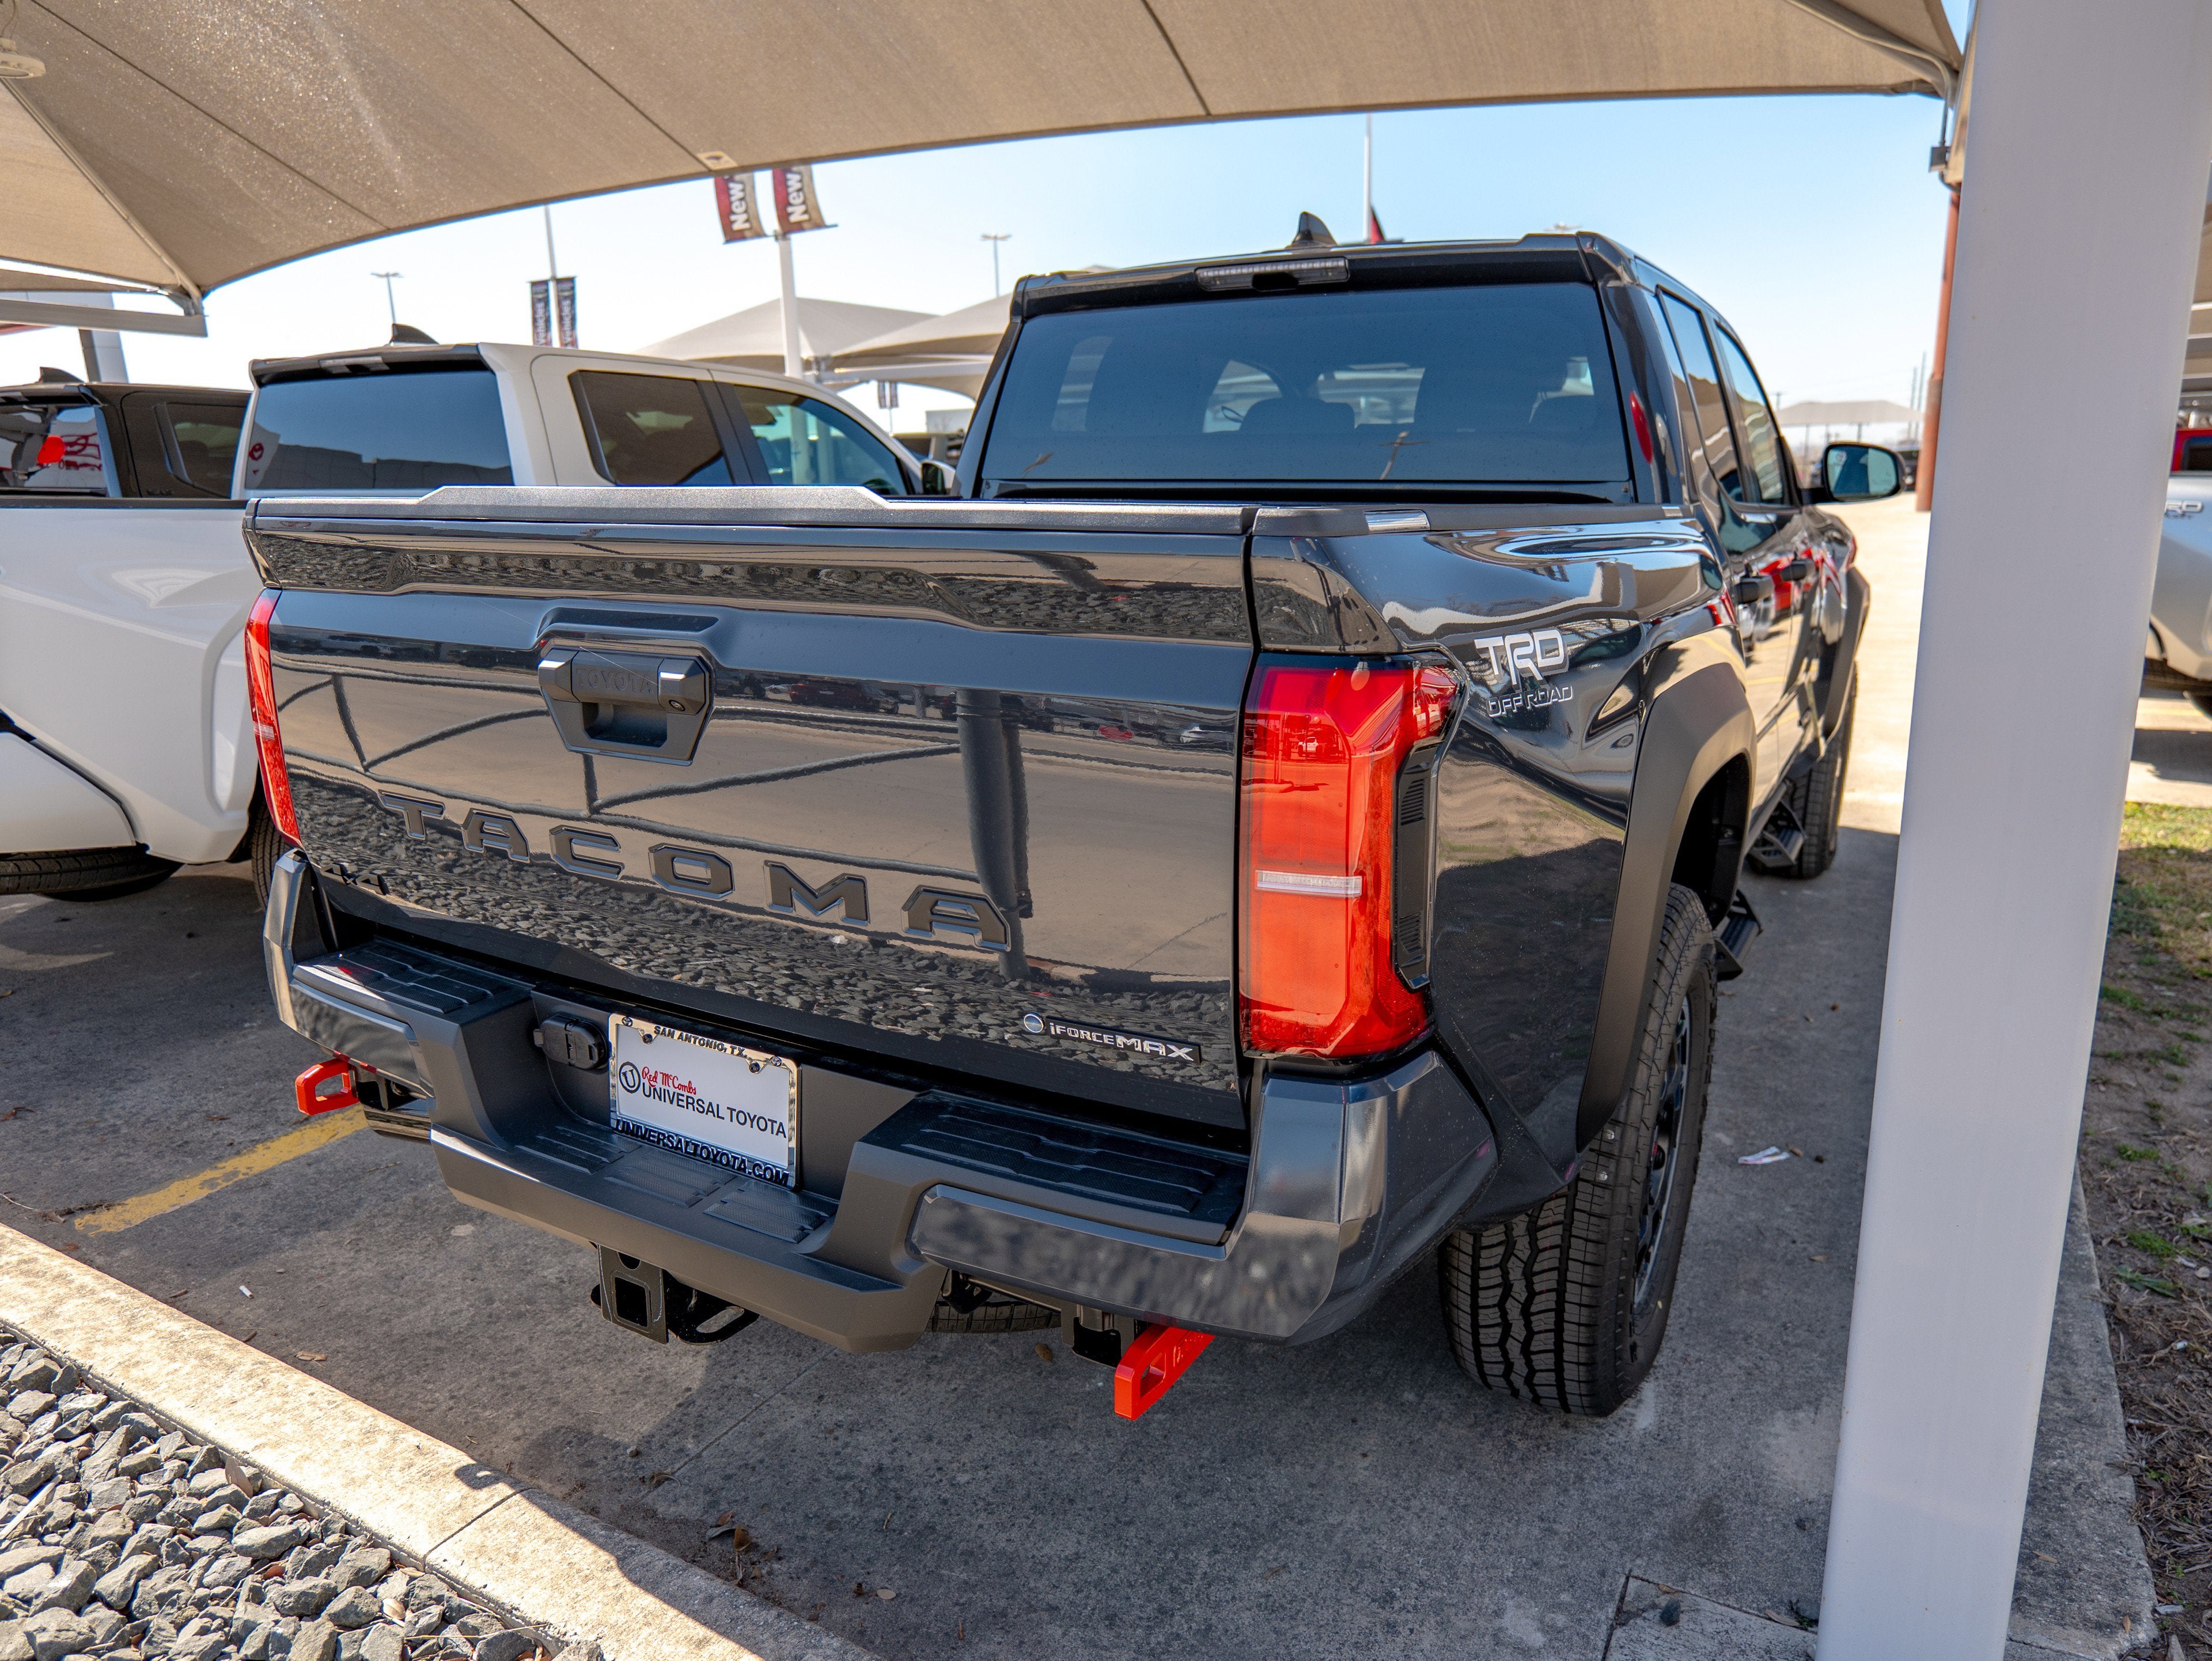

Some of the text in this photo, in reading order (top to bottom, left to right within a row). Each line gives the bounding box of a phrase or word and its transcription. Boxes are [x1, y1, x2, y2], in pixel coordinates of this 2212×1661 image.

[728, 182, 751, 231] New
[786, 172, 810, 223] New
[2164, 501, 2203, 514] RD
[576, 669, 654, 694] TOYOTA
[1474, 629, 1566, 687] TRD
[378, 789, 1011, 952] TACOMA
[654, 1026, 676, 1041] SAN
[677, 1031, 728, 1053] ANTONIO,
[642, 1066, 697, 1095] Red McCombs
[642, 1085, 787, 1138] UNIVERSAL TOYOTA
[614, 1118, 790, 1187] UNIVERSALTOYOTA.COM
